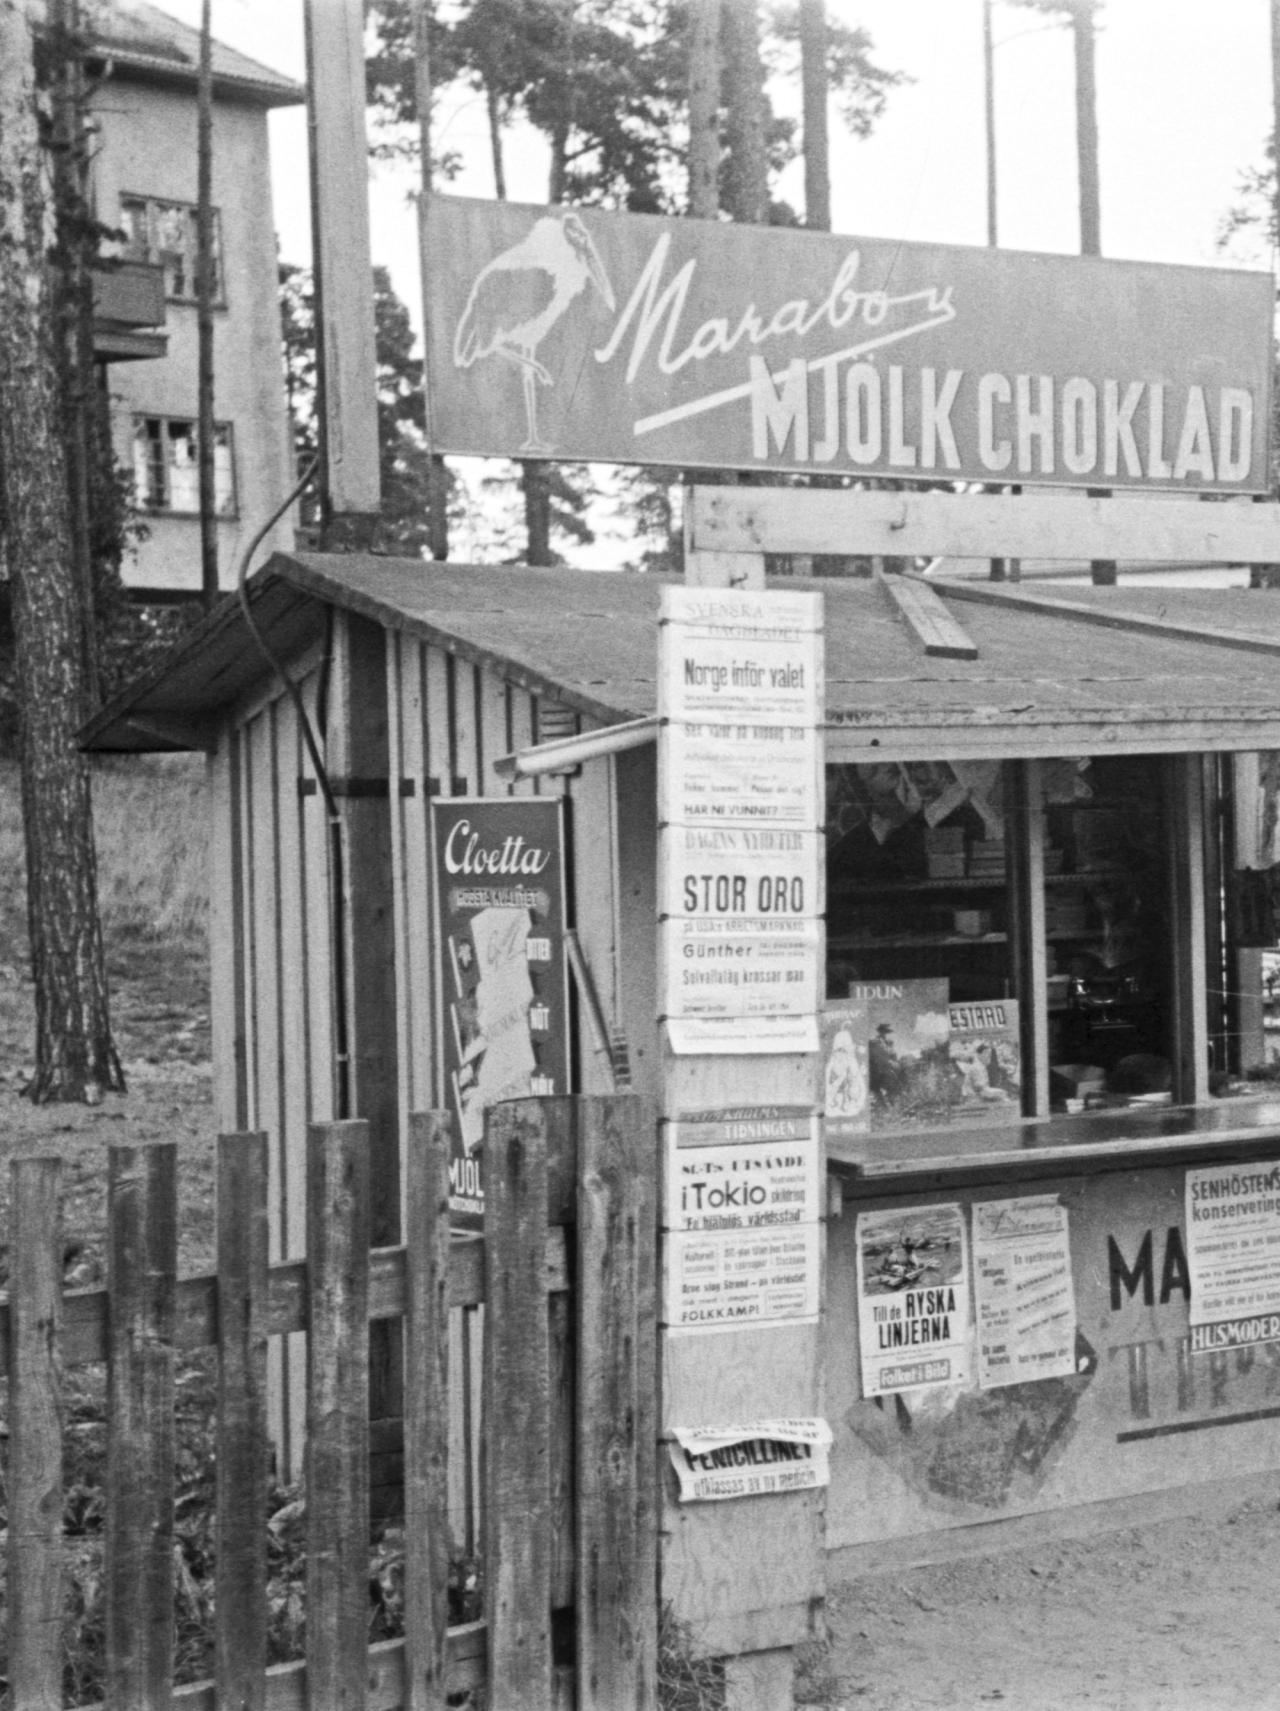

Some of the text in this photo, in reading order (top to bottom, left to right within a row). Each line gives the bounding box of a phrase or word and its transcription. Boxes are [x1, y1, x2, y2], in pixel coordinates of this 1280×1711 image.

[593, 232, 957, 385] Marabou
[749, 352, 1256, 483] MJÖLK CHOKLAD
[684, 658, 805, 692] Norge inför valet
[684, 804, 708, 815] HAR
[444, 819, 551, 874] Cloetta
[685, 831, 803, 850] DAGENS NYHETER
[684, 874, 804, 913] STOR ORO
[683, 943, 752, 958] Günther
[855, 986, 903, 999] IDUN
[724, 1121, 796, 1139] TIDNINGEN
[732, 1154, 806, 1172] UTSÄNDE
[682, 1180, 767, 1210] i Tokio
[873, 1288, 956, 1322] Till de RYSKA
[879, 1315, 950, 1349] LINJERNA
[881, 1367, 916, 1386] Folket
[918, 1365, 923, 1381] i
[925, 1361, 948, 1379] Bild
[778, 1467, 816, 1487] medicin
